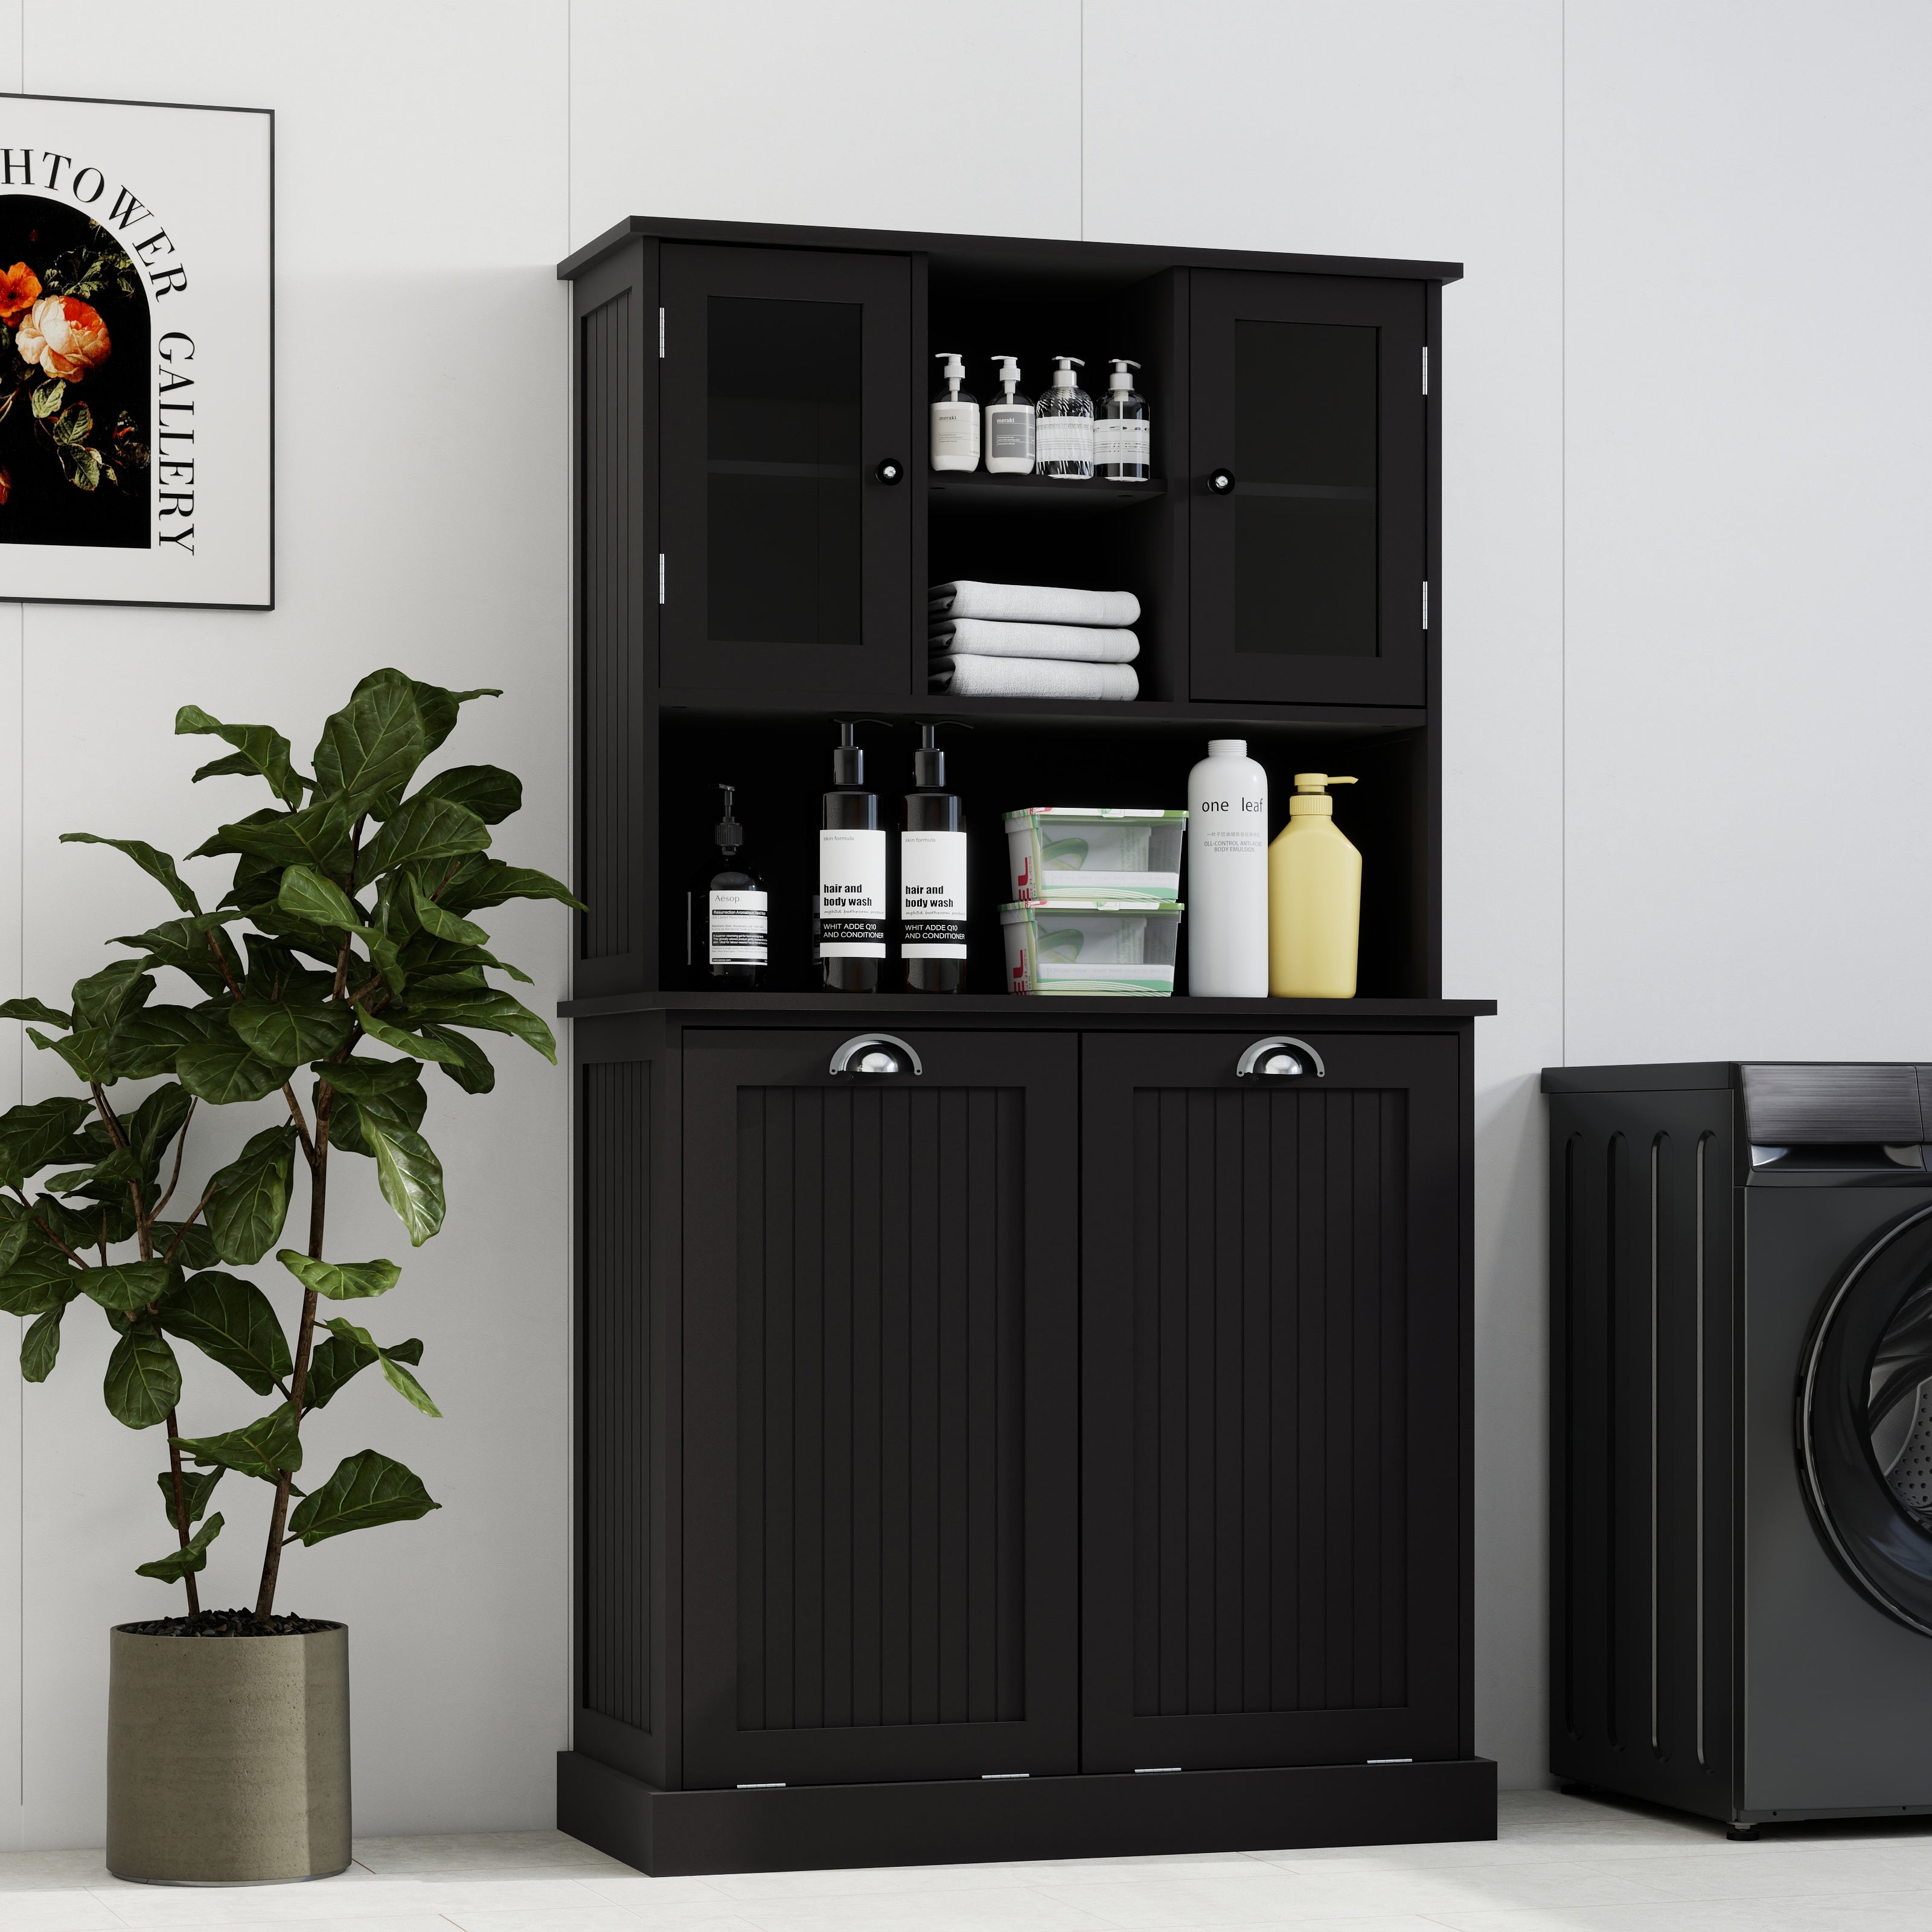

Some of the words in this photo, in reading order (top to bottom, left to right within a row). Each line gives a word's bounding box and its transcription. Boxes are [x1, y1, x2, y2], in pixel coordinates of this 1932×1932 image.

[0, 149, 188, 302] HTOWER
[158, 331, 195, 556] GALLERY
[1202, 801, 1229, 812] one
[1242, 797, 1263, 812] leaf
[824, 884, 842, 893] hair
[844, 884, 862, 893] and
[906, 885, 924, 894] hair
[926, 885, 944, 894] and
[824, 897, 846, 907] body
[848, 897, 872, 906] wash
[906, 898, 928, 908] body
[930, 898, 953, 907] wash
